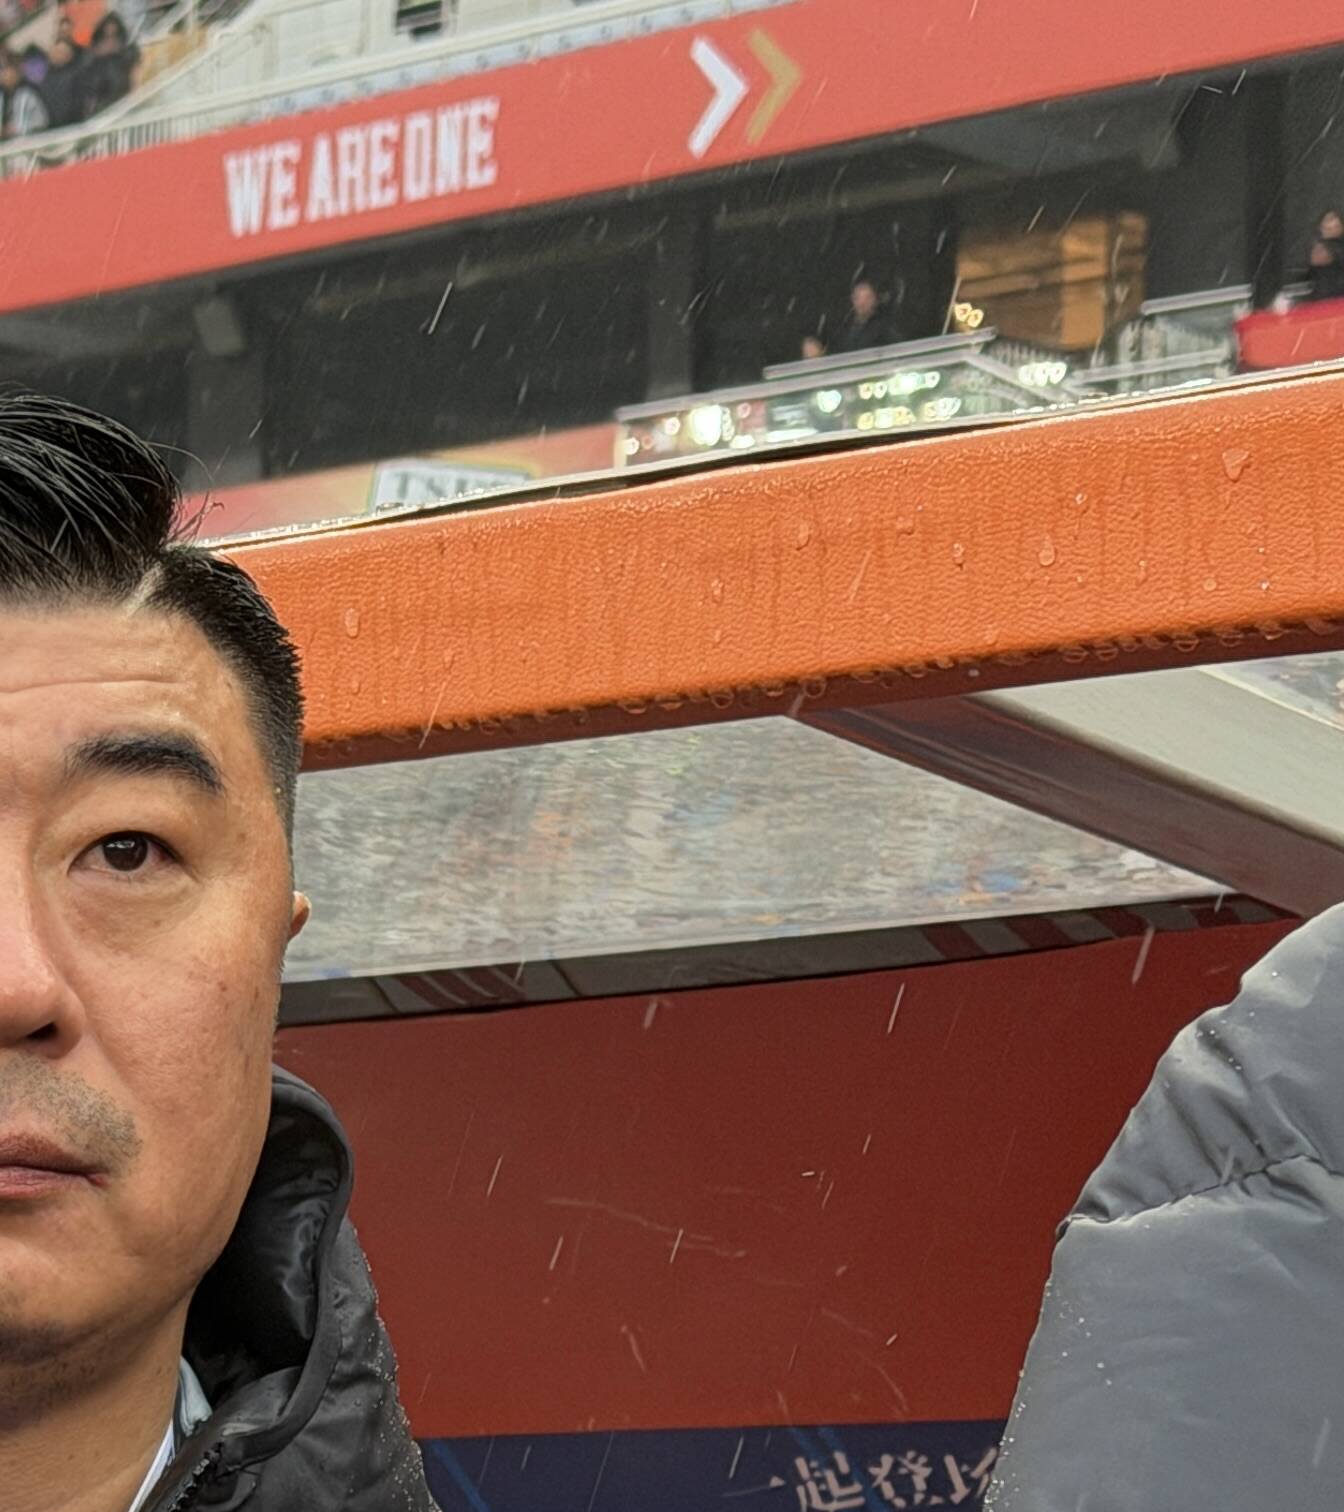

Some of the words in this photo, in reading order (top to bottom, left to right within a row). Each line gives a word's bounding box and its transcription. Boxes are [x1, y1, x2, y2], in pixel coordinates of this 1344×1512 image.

[223, 140, 300, 237] WE
[306, 115, 400, 223] ARE
[403, 98, 500, 200] ONE
